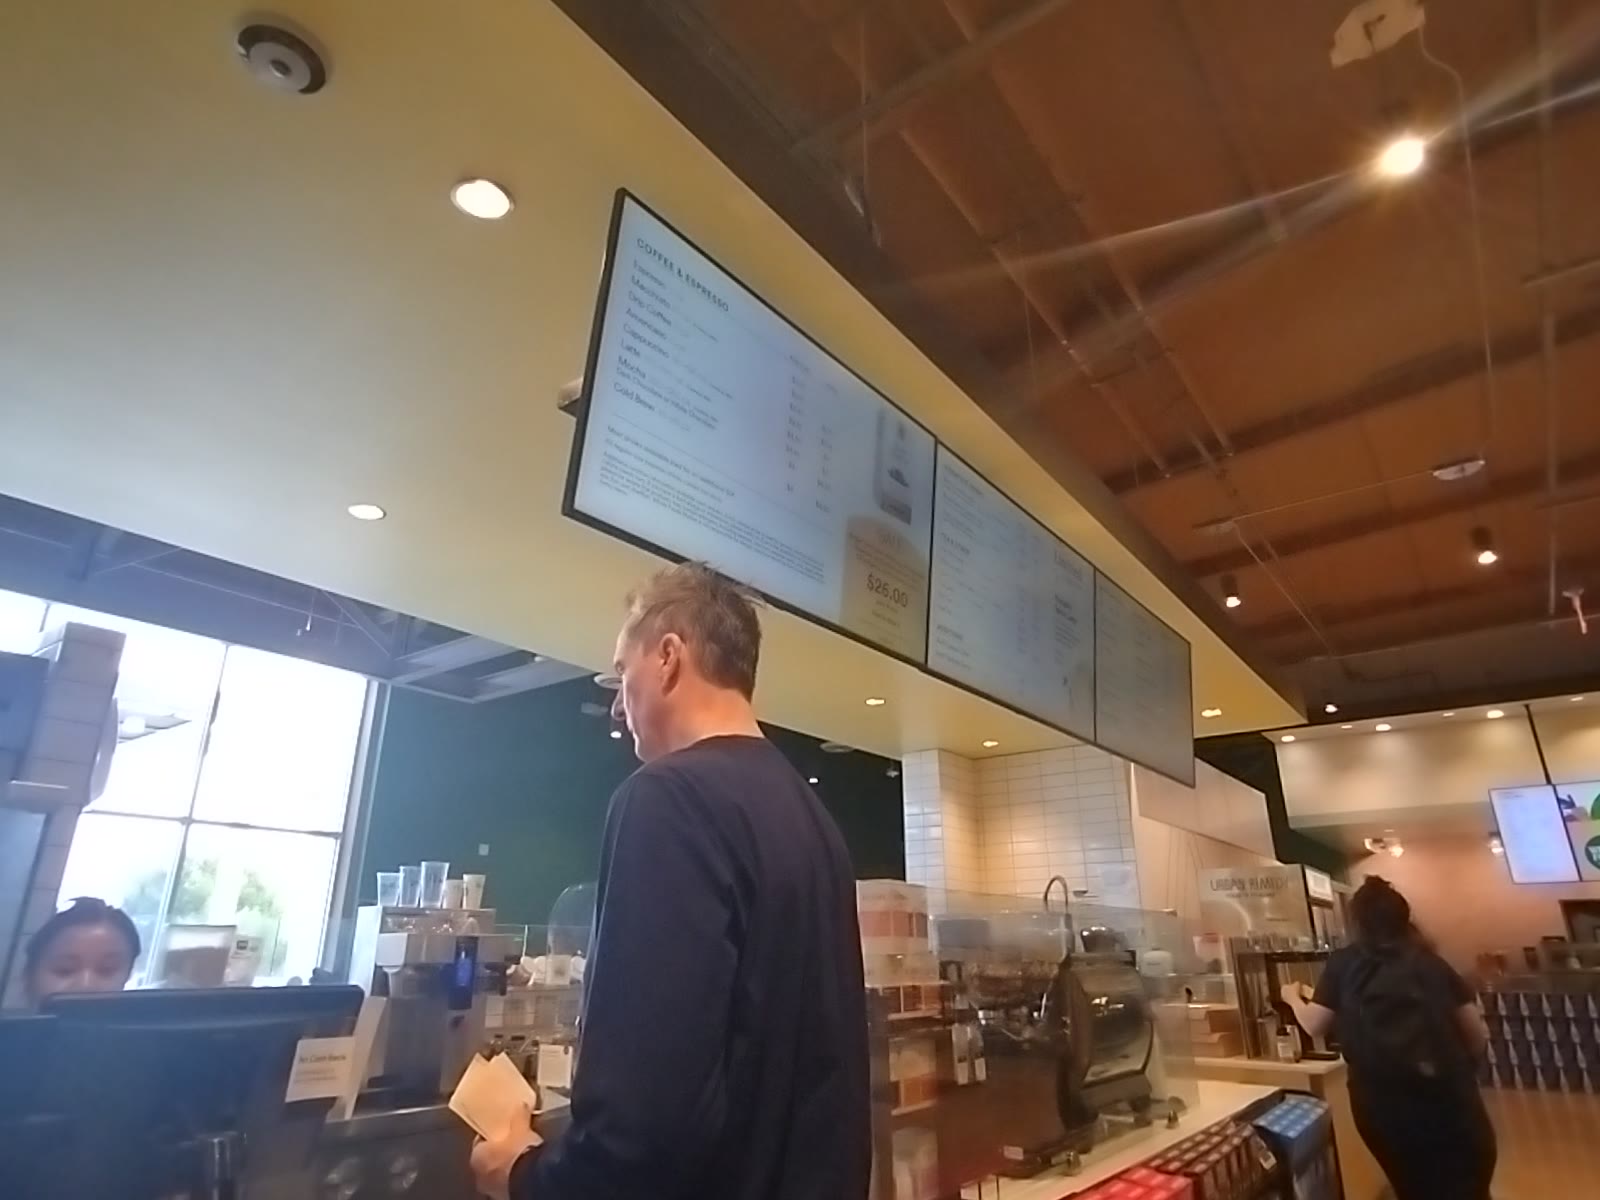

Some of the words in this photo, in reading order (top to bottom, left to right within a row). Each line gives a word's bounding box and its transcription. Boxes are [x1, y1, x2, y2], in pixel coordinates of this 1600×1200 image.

[636, 238, 674, 272] COFFEE
[685, 273, 729, 312] ESPRESSO
[866, 572, 909, 608] $26.00
